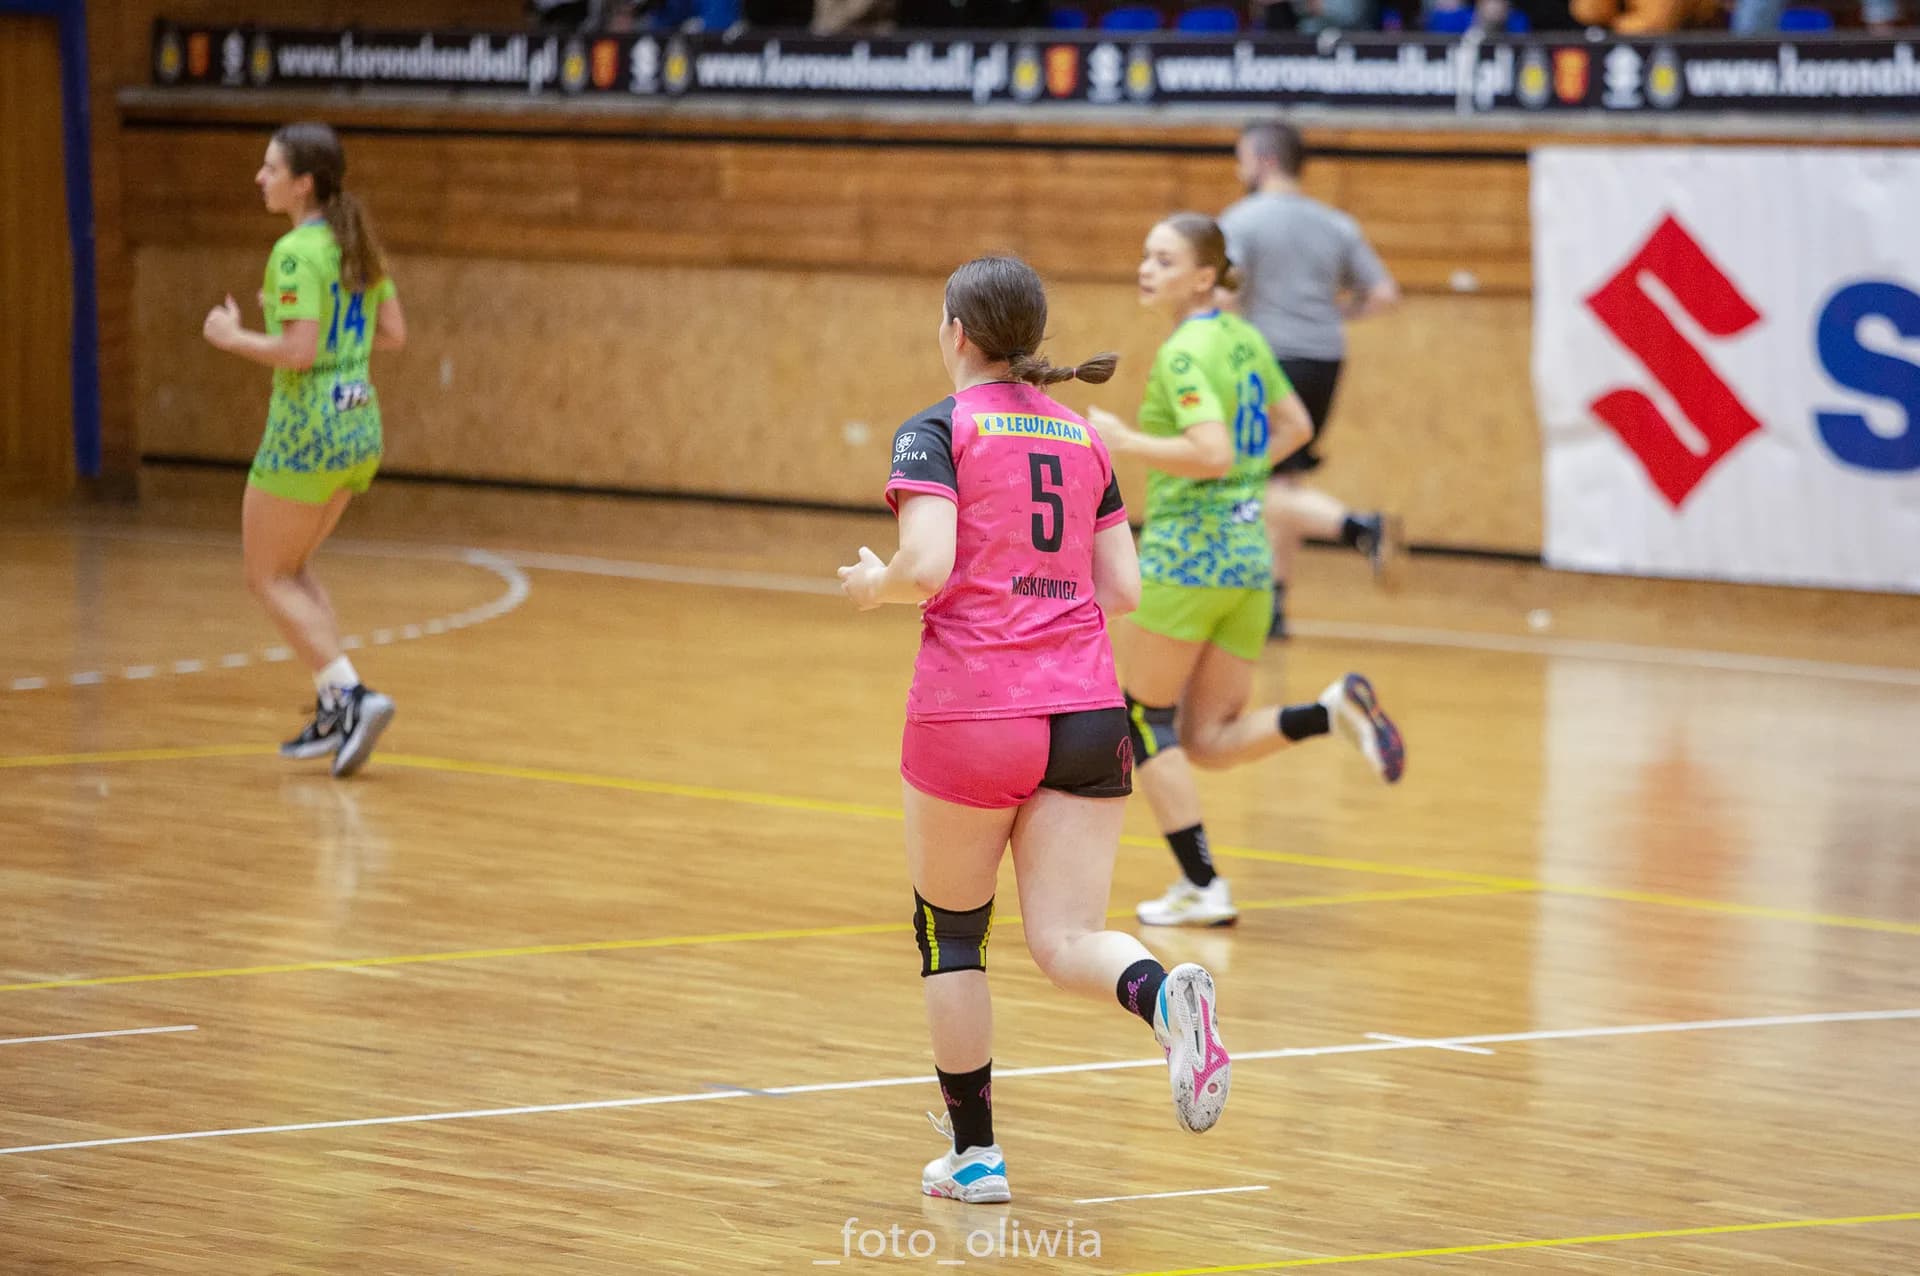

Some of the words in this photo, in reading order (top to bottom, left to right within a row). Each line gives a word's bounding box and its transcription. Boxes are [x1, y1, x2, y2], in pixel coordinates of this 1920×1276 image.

[276, 32, 557, 93] www.koronahandball.pl
[696, 39, 1008, 103] www.koronahandball.pl
[326, 282, 367, 351] 14
[1006, 415, 1083, 441] LEWIATAN
[1029, 453, 1064, 552] 5
